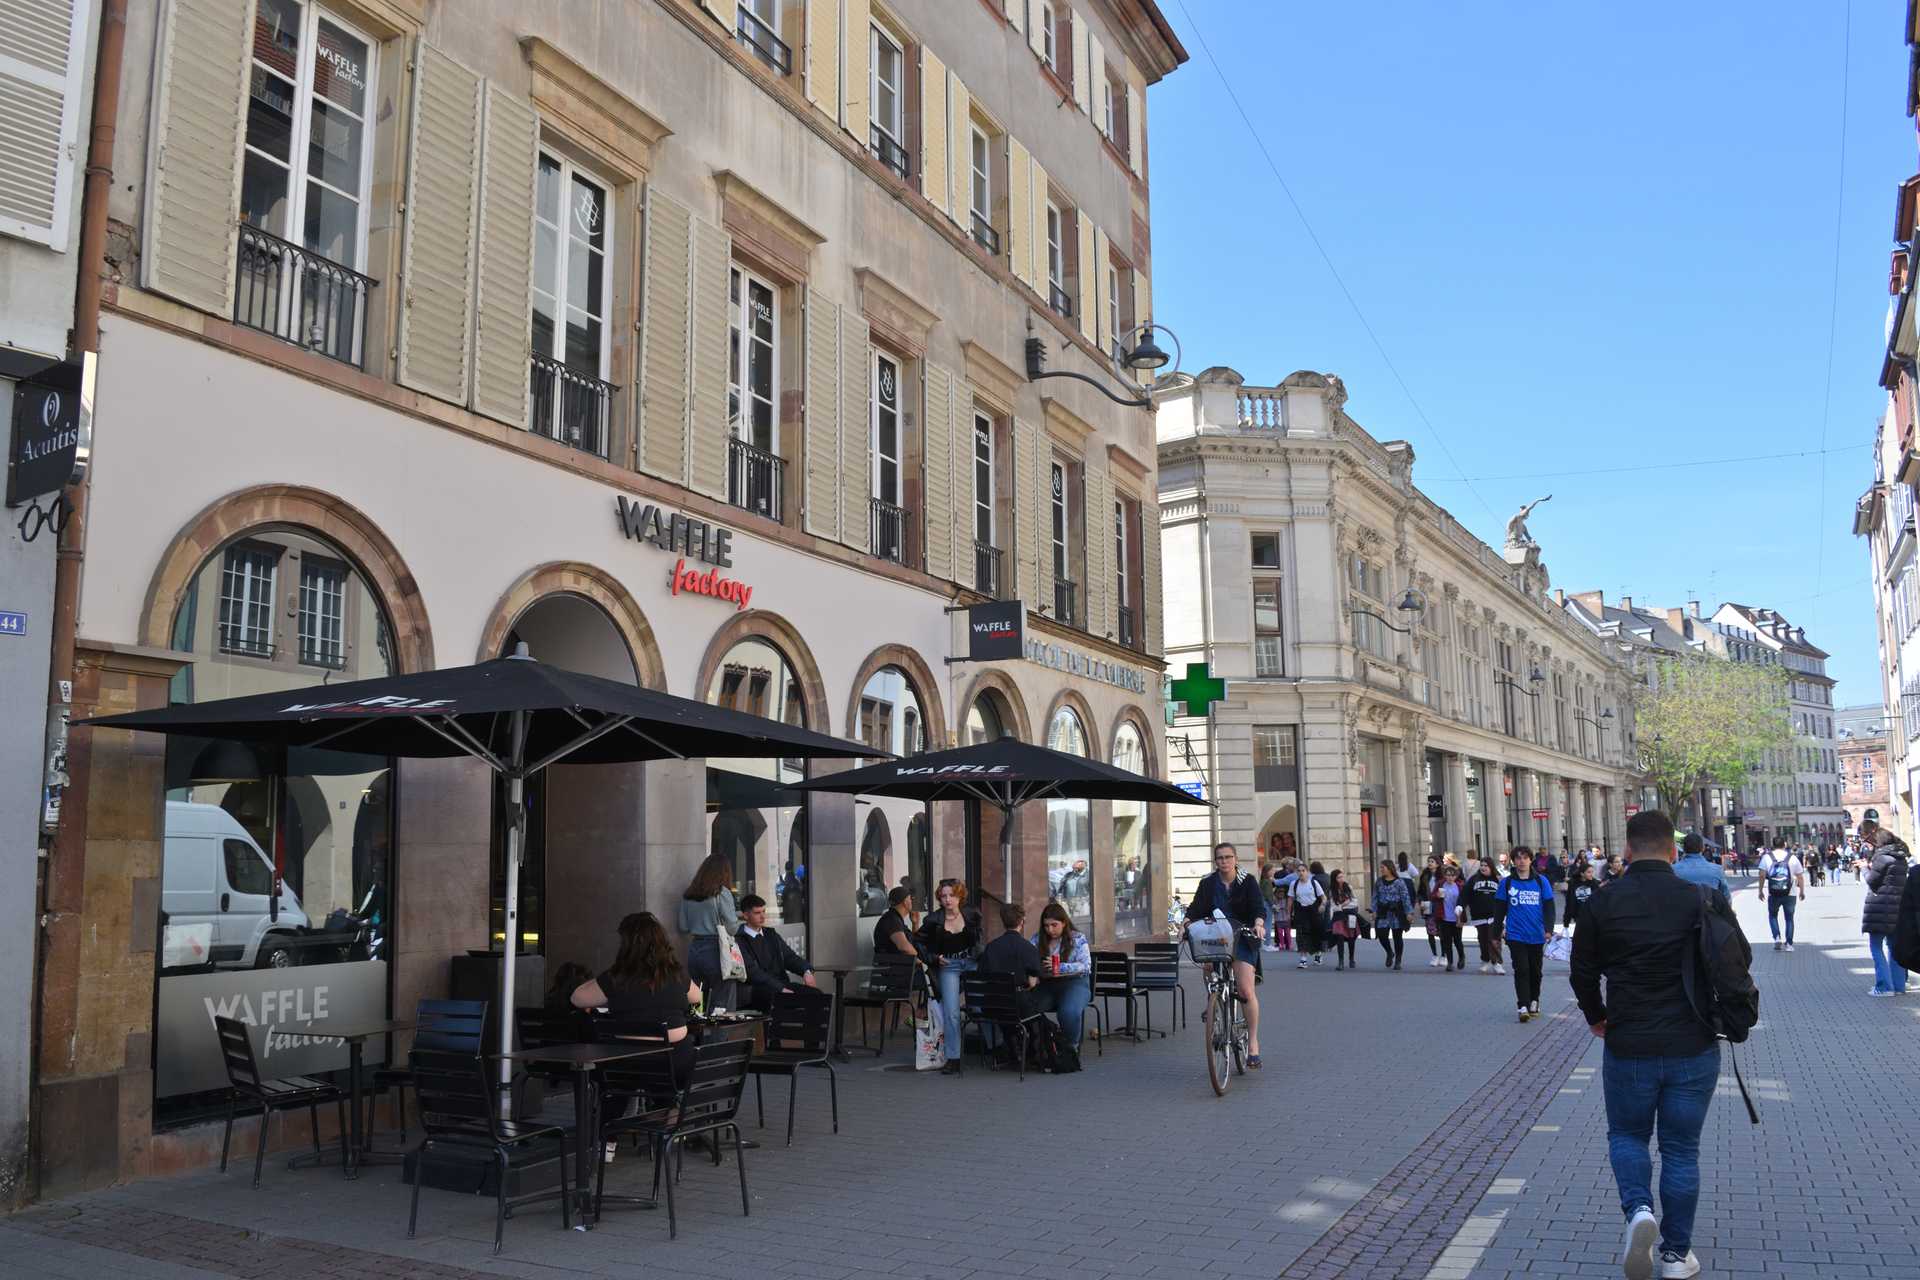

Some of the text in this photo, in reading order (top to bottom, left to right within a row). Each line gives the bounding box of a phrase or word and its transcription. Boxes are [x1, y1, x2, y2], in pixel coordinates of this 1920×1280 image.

[317, 42, 359, 76] WAFFLE
[20, 422, 78, 463] Acuitis
[616, 495, 733, 569] WAFFLE
[671, 558, 753, 611] factory
[973, 621, 1011, 633] WAFFLE
[896, 764, 1010, 776] WAFFLE
[203, 986, 329, 1031] WAFFLE
